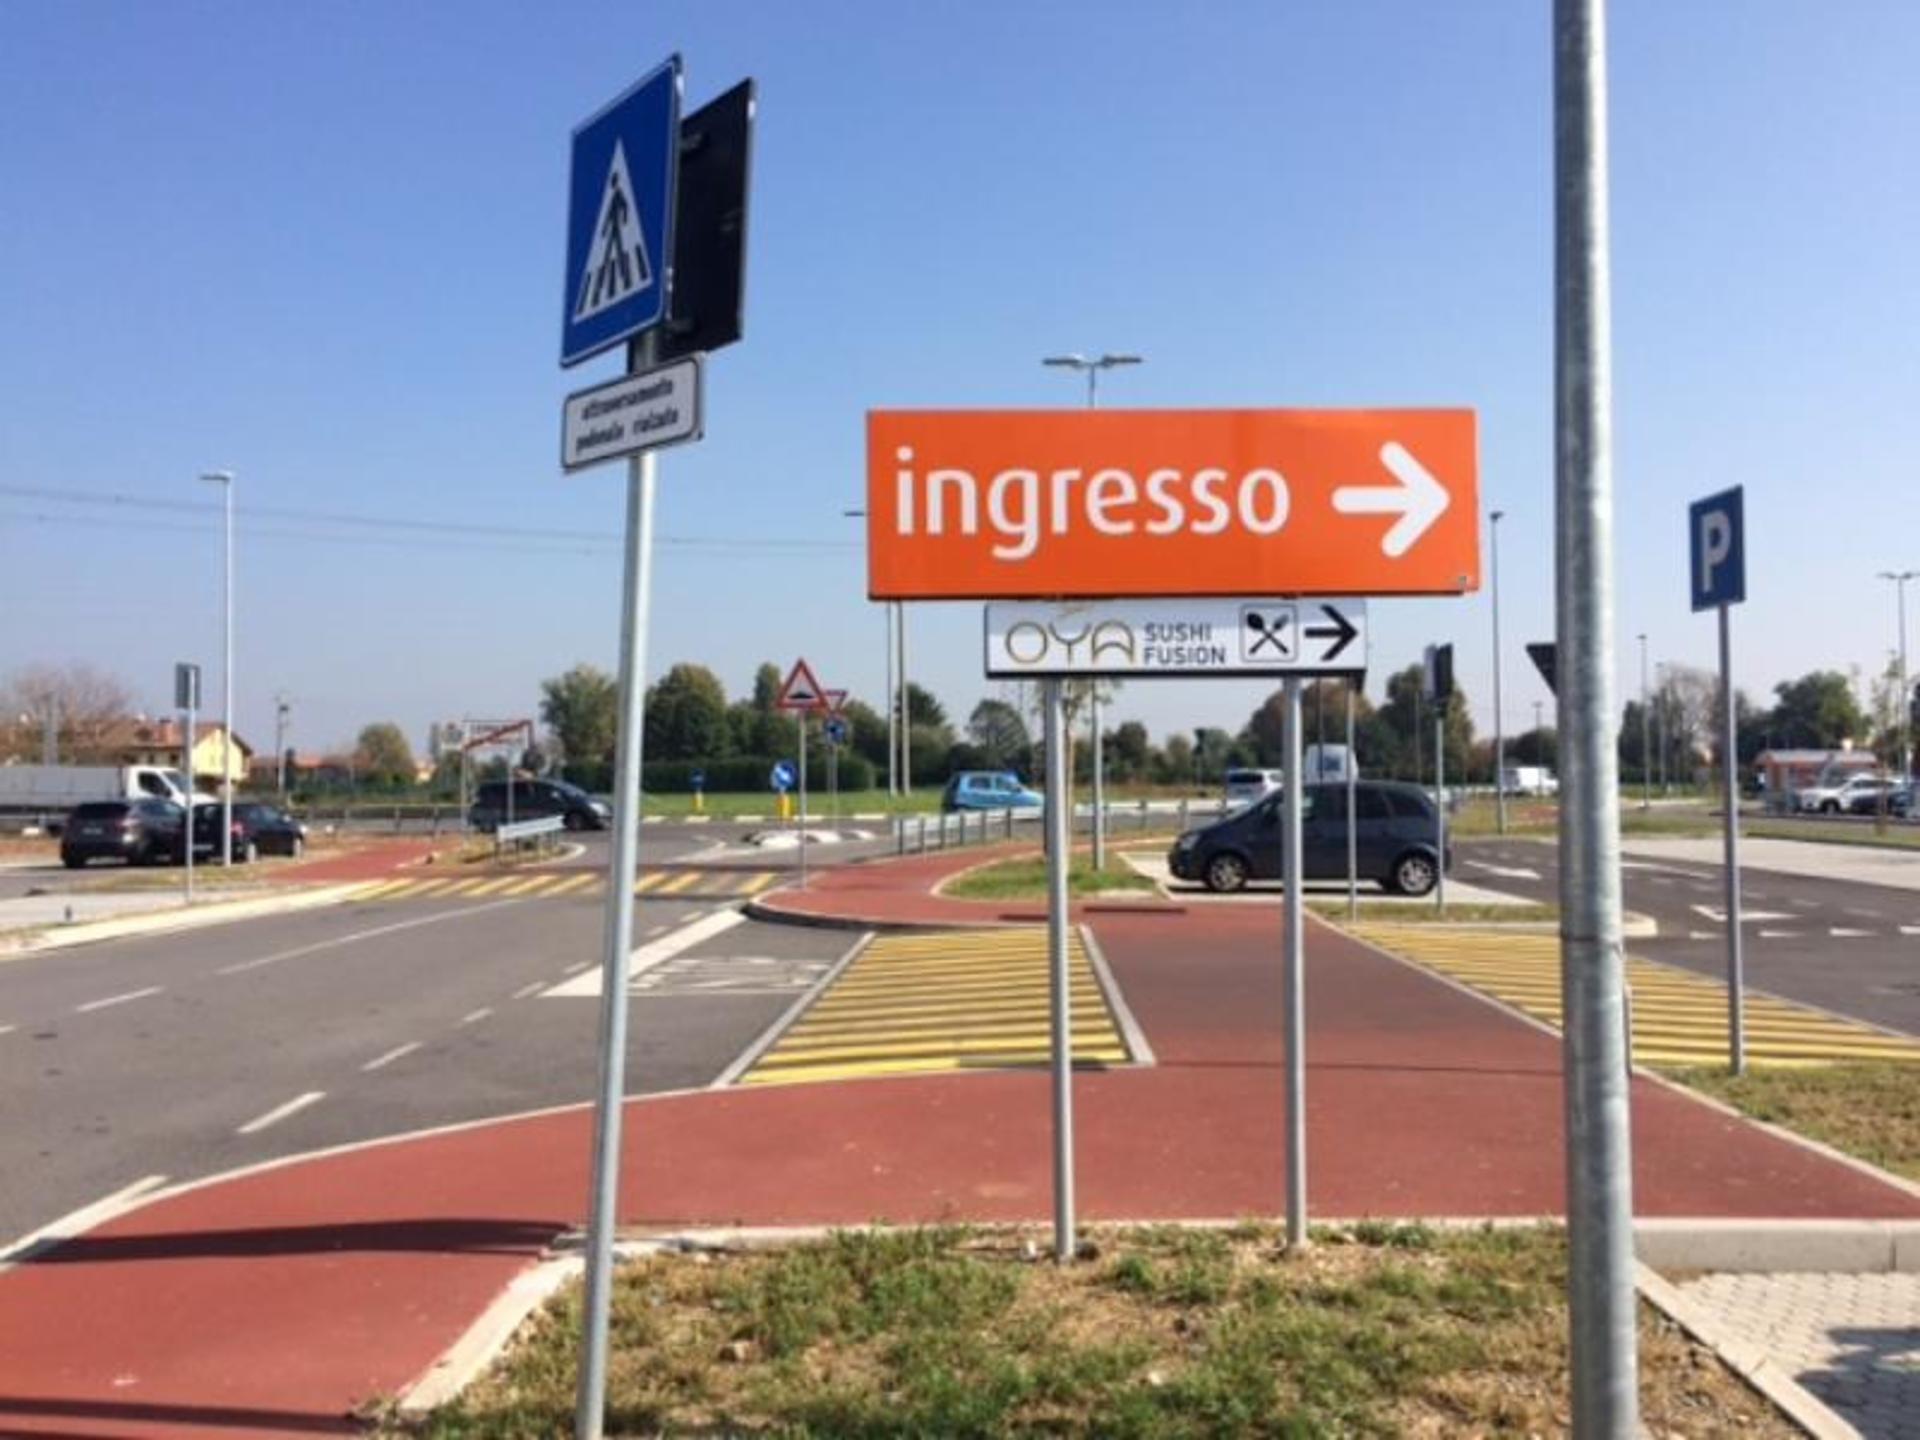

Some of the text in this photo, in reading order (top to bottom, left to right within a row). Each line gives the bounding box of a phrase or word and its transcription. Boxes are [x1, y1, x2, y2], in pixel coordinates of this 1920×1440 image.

[896, 446, 1290, 559] ingresso
[1701, 510, 1731, 592] P
[1005, 620, 1135, 665] OYA
[1143, 623, 1212, 643] SUSHI
[1143, 646, 1226, 665] FUSION
